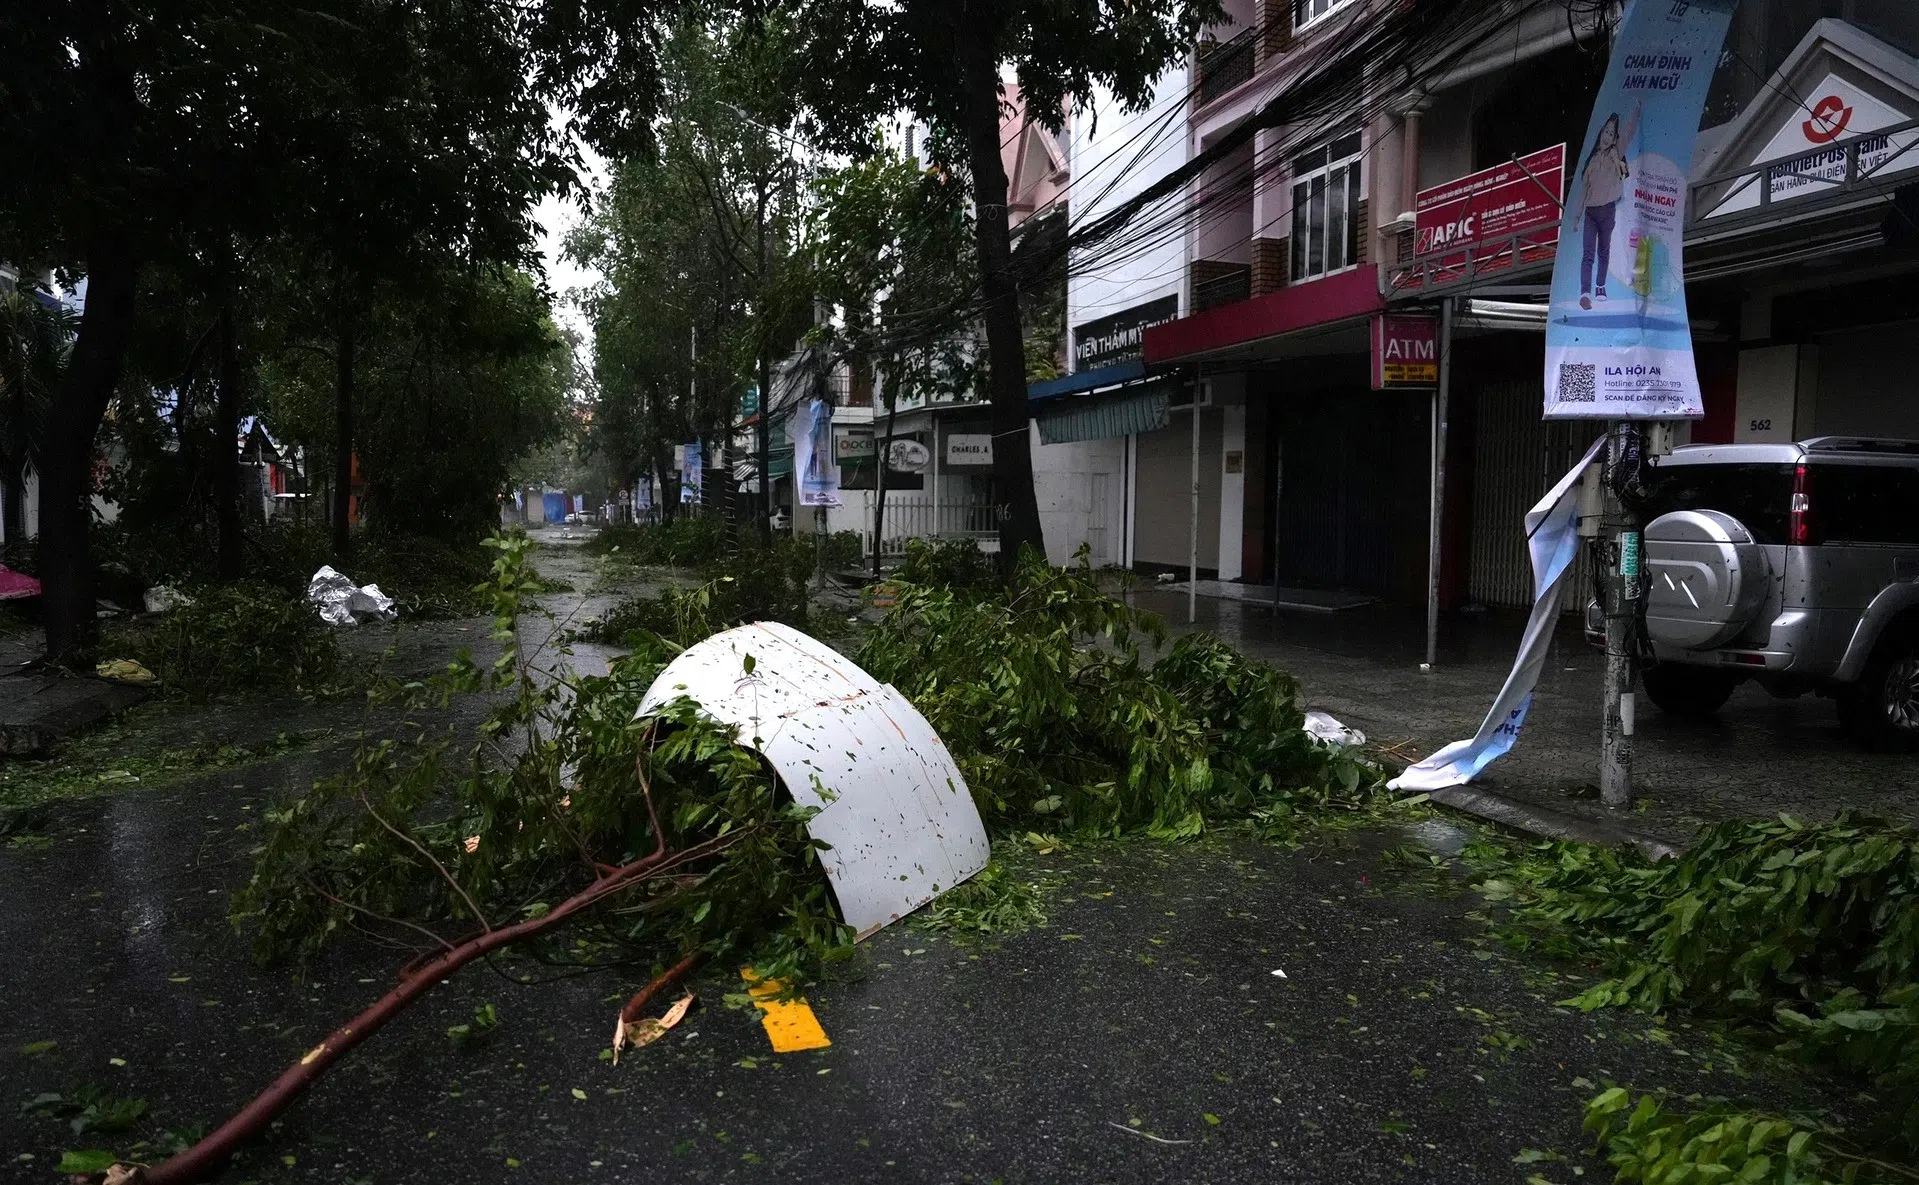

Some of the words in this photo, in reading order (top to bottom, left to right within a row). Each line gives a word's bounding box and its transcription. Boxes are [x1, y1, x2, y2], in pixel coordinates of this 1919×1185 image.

[1624, 54, 1657, 72] CHẠM
[1658, 51, 1692, 70] ĐỈNH
[1623, 75, 1647, 89] ANH
[1648, 72, 1681, 90] NGỮ
[1655, 194, 1677, 208] NGAY
[1076, 337, 1098, 361] VIỆN
[1098, 322, 1127, 353] THẨM
[1385, 338, 1434, 359] ATM
[1605, 367, 1622, 375] ILA
[1626, 364, 1646, 377] HỘI
[1649, 366, 1661, 375] AN
[1605, 379, 1634, 388] Hotline:
[1635, 379, 1655, 388] 0235
[1668, 395, 1684, 403] NGAY
[1750, 419, 1771, 431] 562
[951, 445, 979, 453] CHARLES
